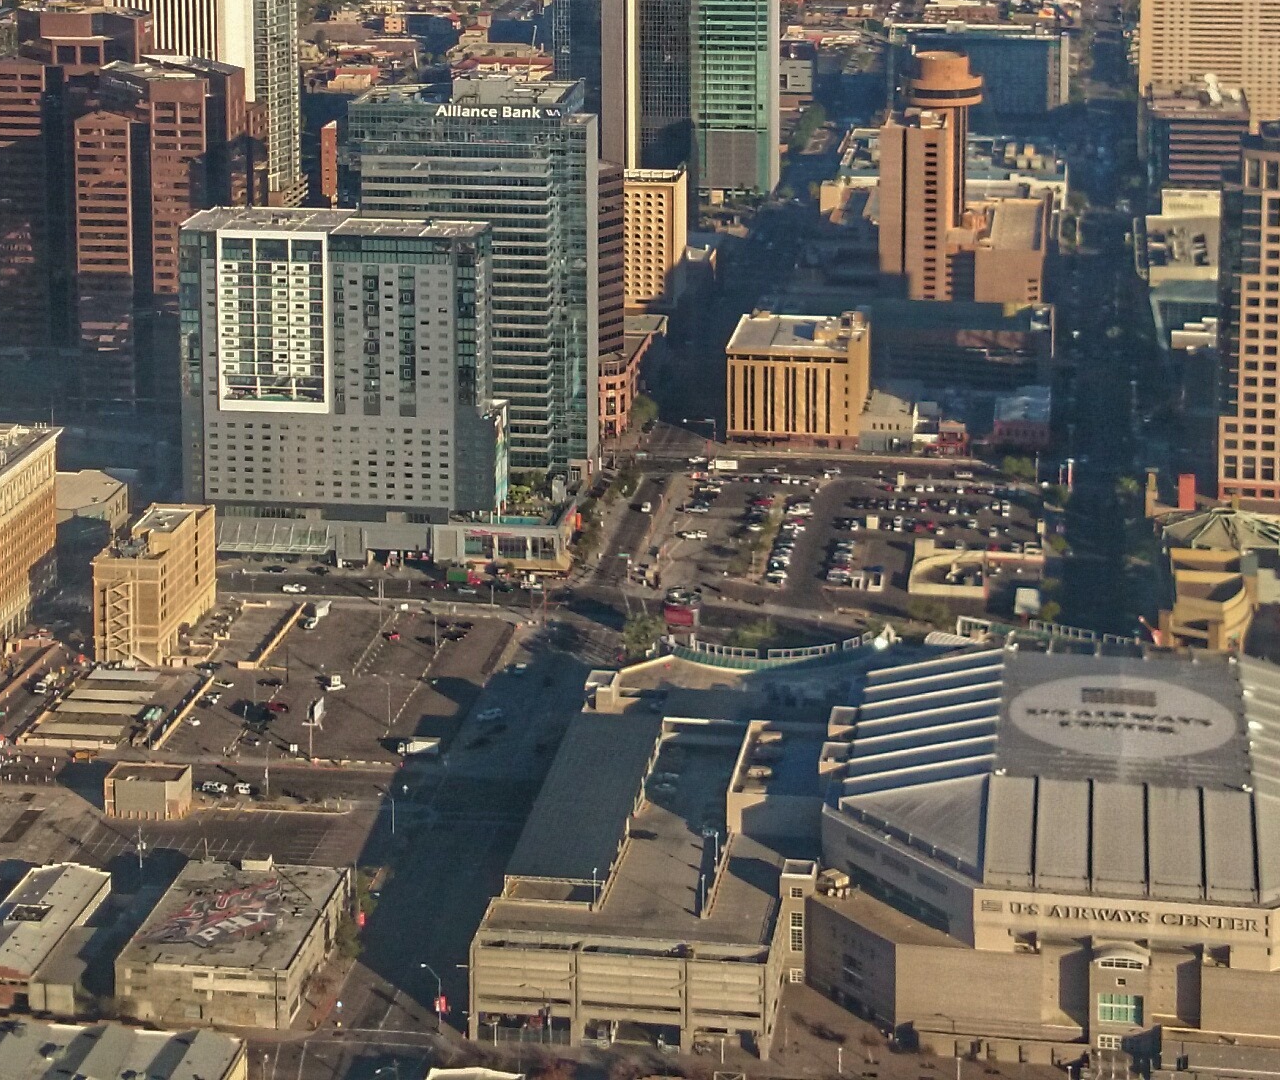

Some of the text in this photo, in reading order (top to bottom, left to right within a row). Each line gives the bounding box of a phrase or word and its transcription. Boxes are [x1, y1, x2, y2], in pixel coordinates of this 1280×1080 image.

[435, 105, 497, 118] Alliance
[502, 106, 541, 119] Bank
[196, 908, 277, 941] PHX
[1047, 904, 1150, 924] AIRWAYS
[1160, 913, 1259, 933] CENTER
